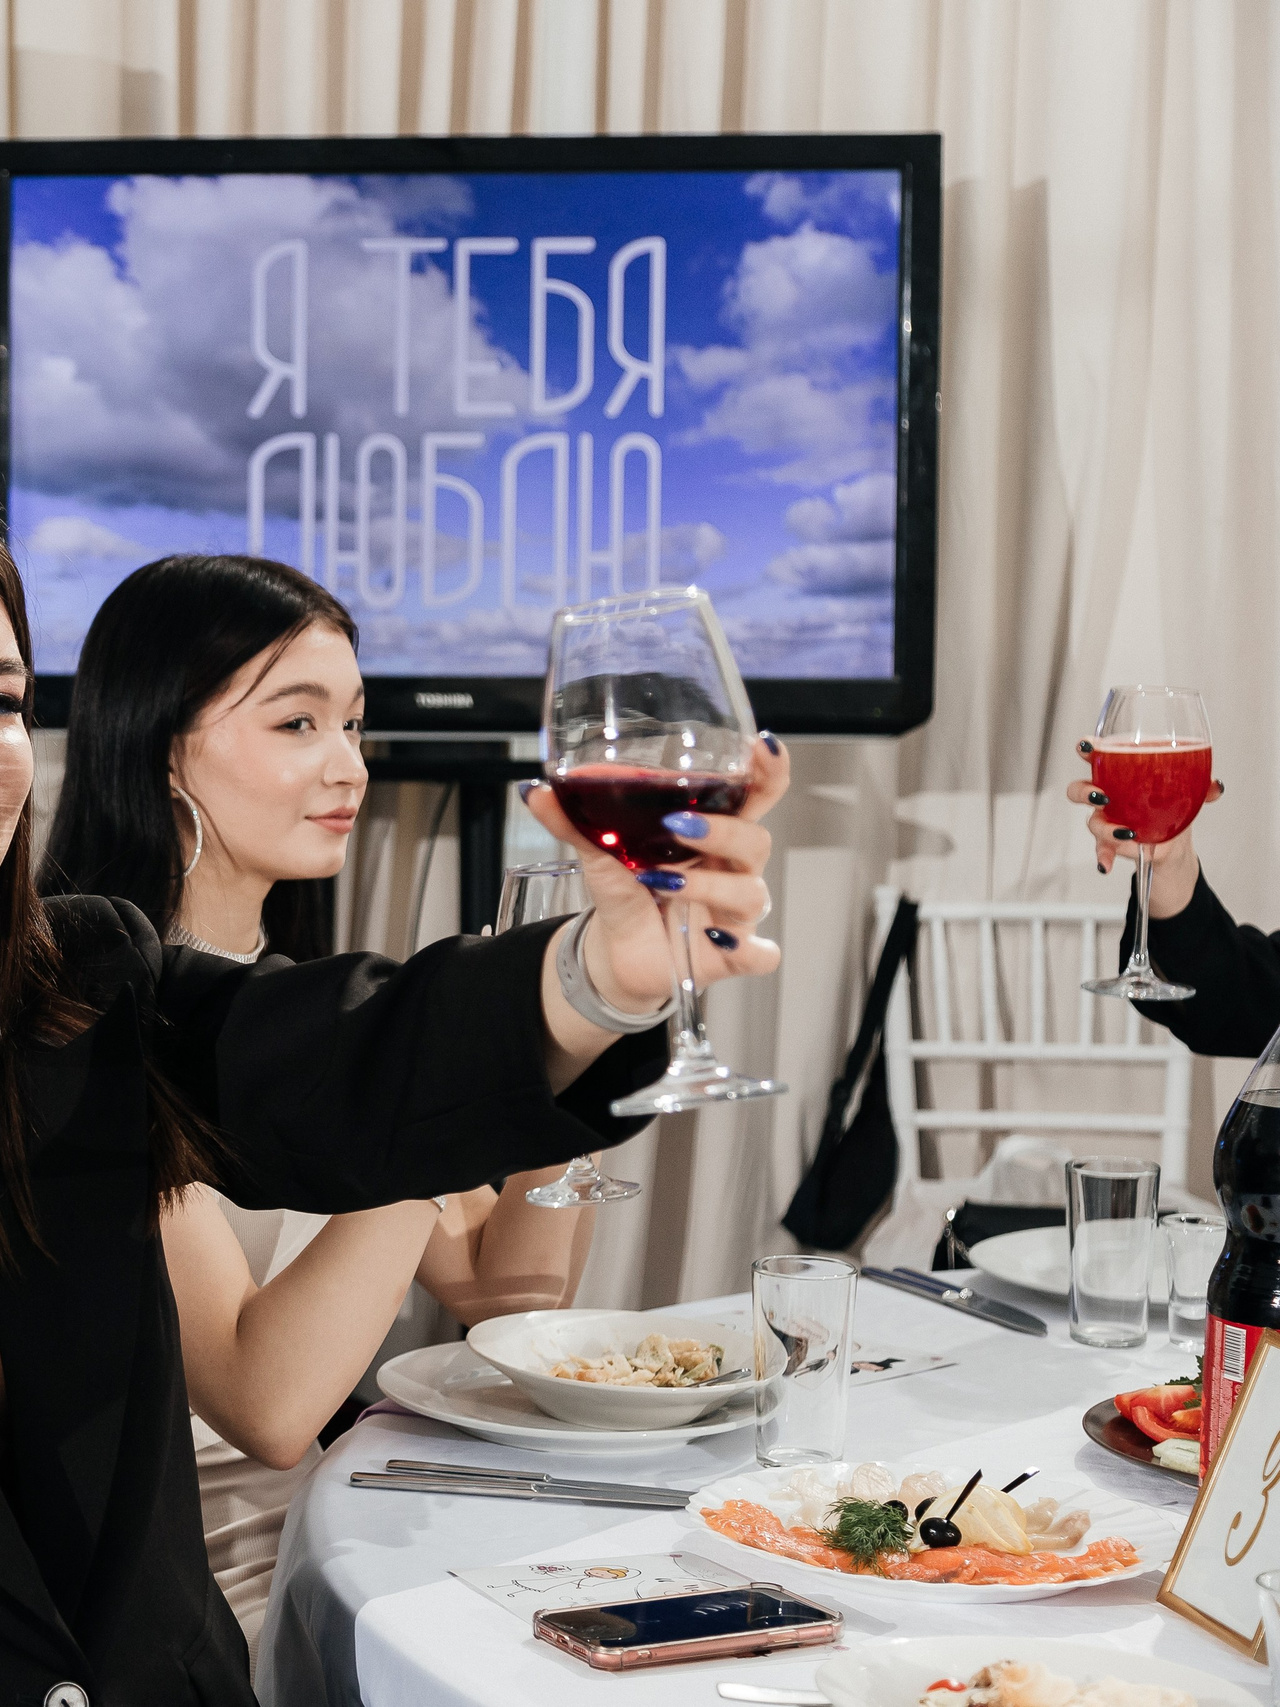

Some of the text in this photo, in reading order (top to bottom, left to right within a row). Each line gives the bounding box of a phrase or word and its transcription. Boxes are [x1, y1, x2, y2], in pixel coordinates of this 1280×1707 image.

[246, 235, 668, 419] Я ТЕБЯ
[246, 431, 663, 609] ЛЮБЛЮ
